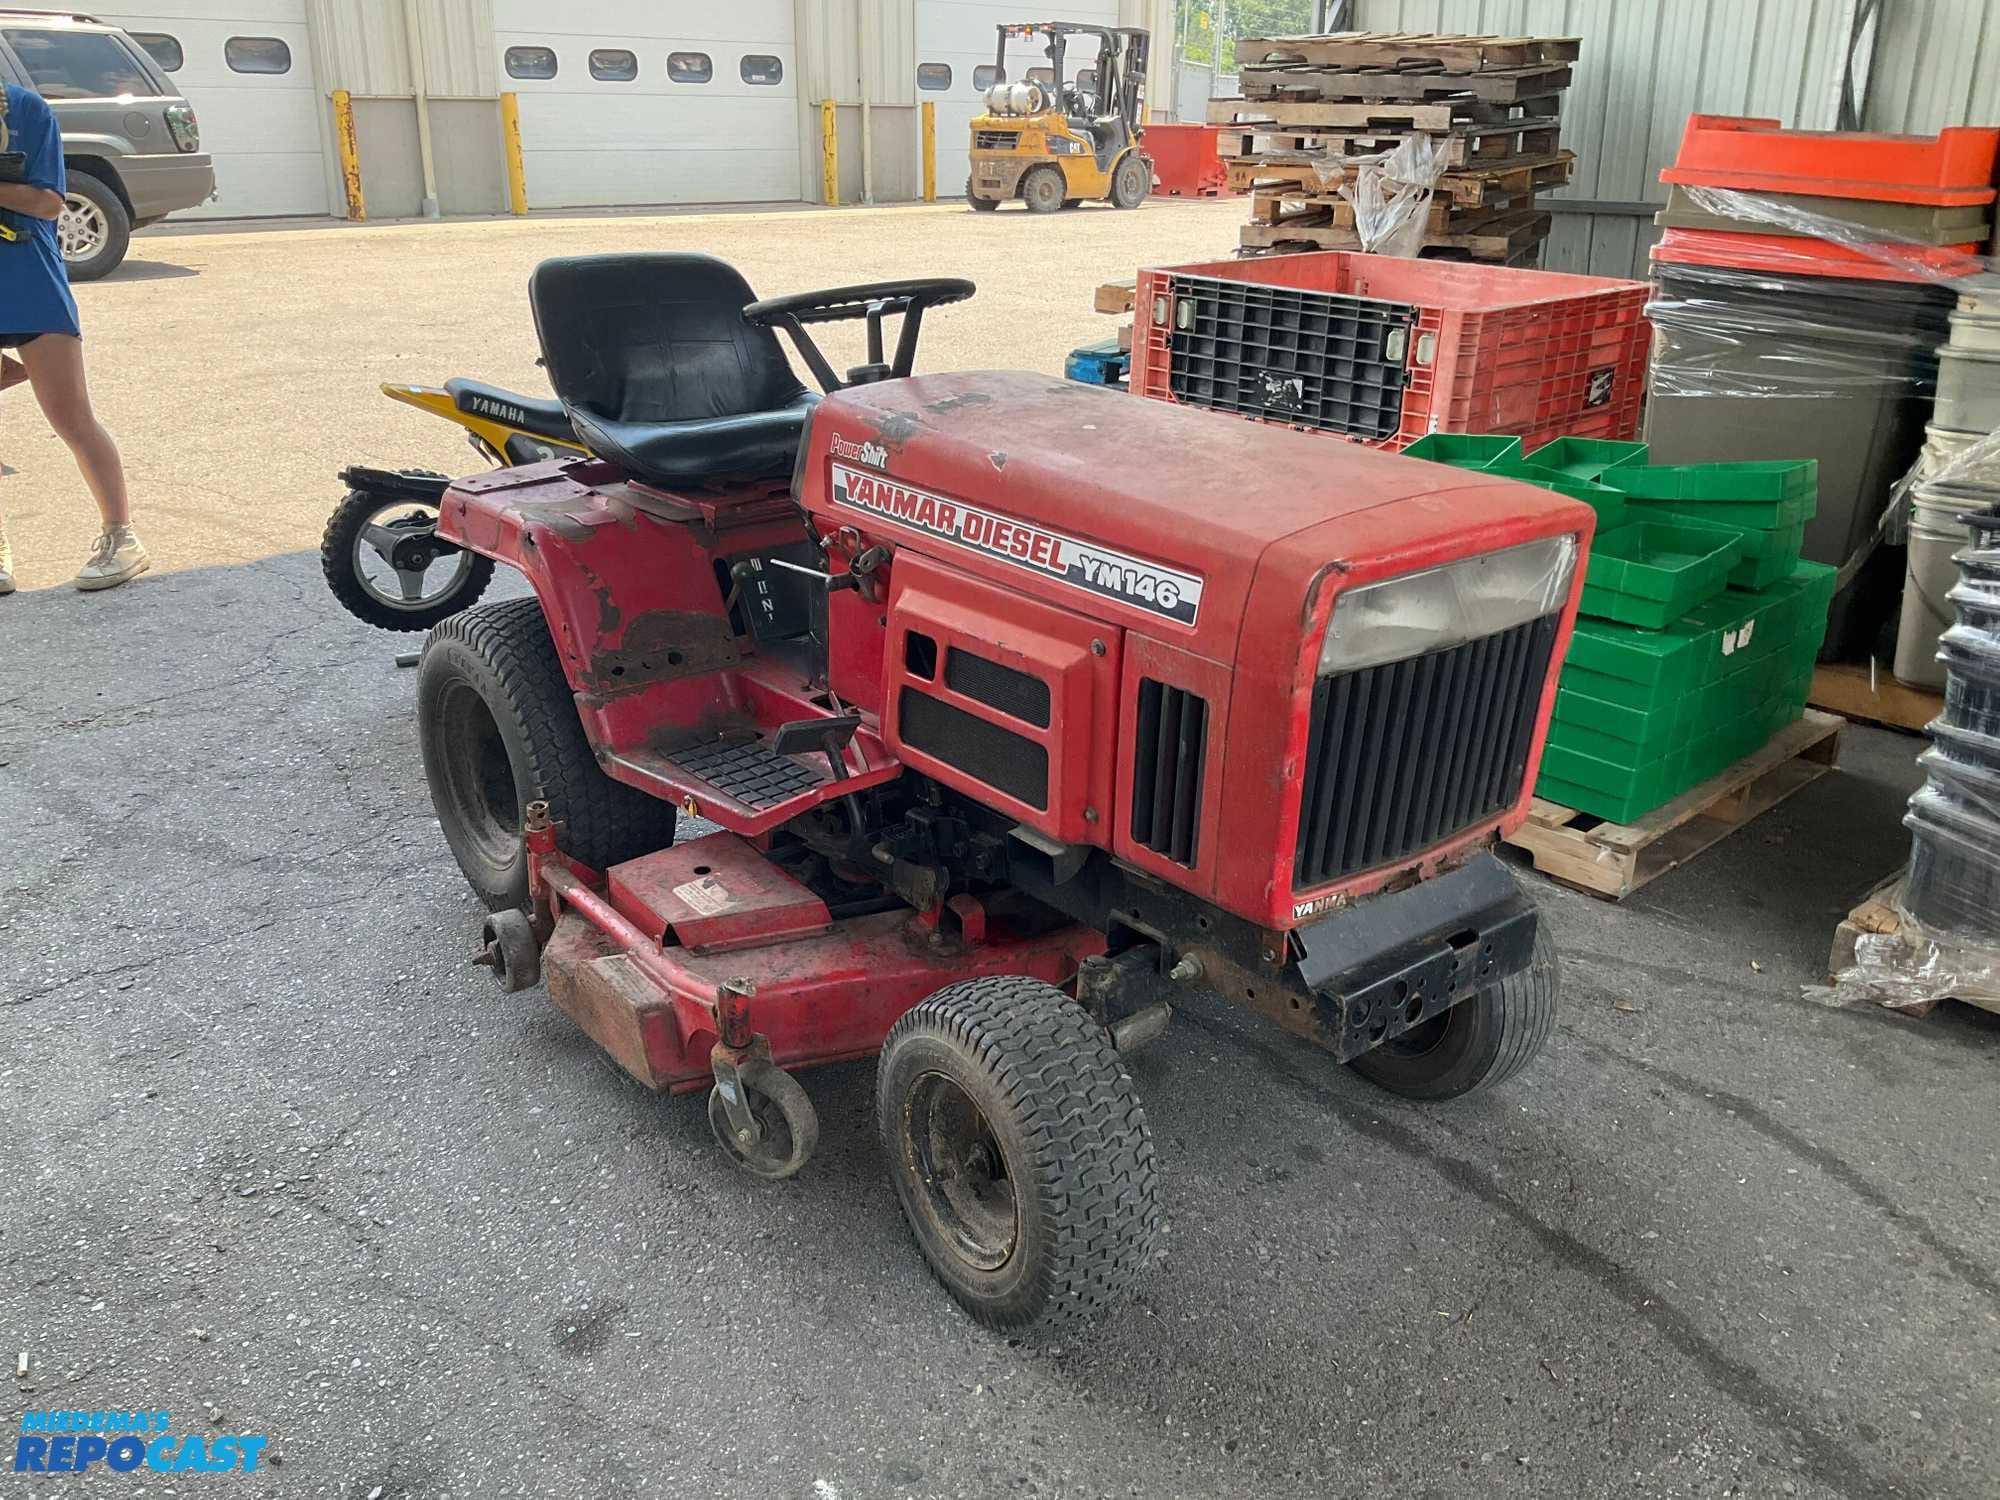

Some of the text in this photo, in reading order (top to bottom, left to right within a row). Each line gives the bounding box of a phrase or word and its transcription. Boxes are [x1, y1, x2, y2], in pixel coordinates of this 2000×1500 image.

[1069, 142, 1081, 154] CAT
[471, 396, 526, 424] YAMAHA
[844, 470, 1181, 610] YANMAR DIESEL YM146
[1293, 892, 1353, 918] YANMA
